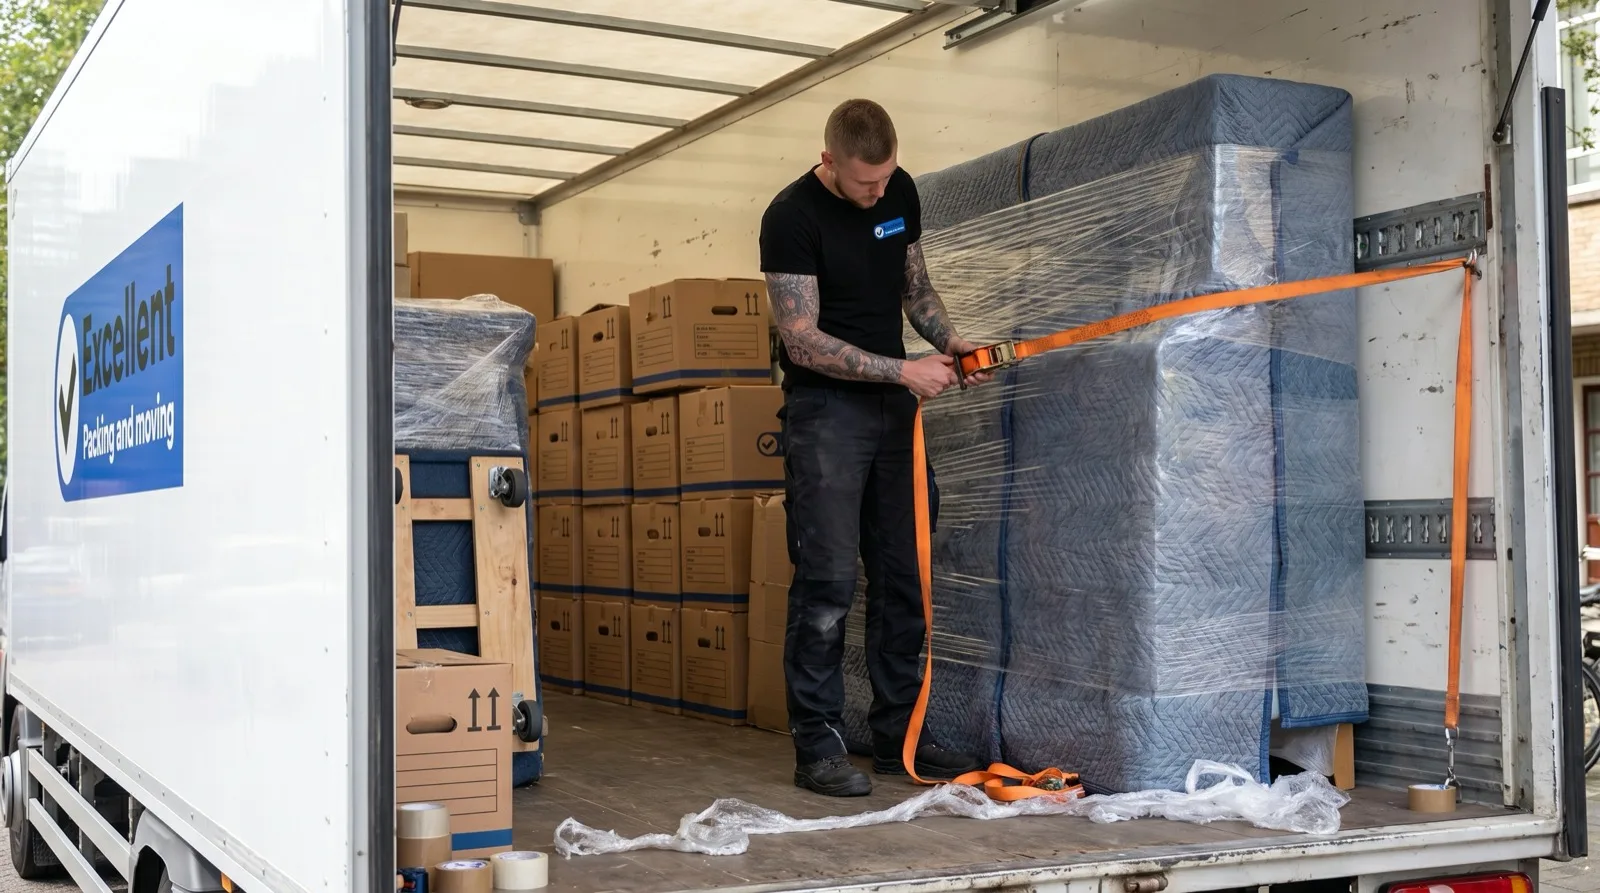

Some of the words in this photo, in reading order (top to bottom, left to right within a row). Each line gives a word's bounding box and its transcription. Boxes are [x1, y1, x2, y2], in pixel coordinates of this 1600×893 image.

[82, 263, 175, 397] Excellent
[83, 413, 115, 465] Packing
[116, 404, 134, 451] and
[135, 391, 174, 451] moving
